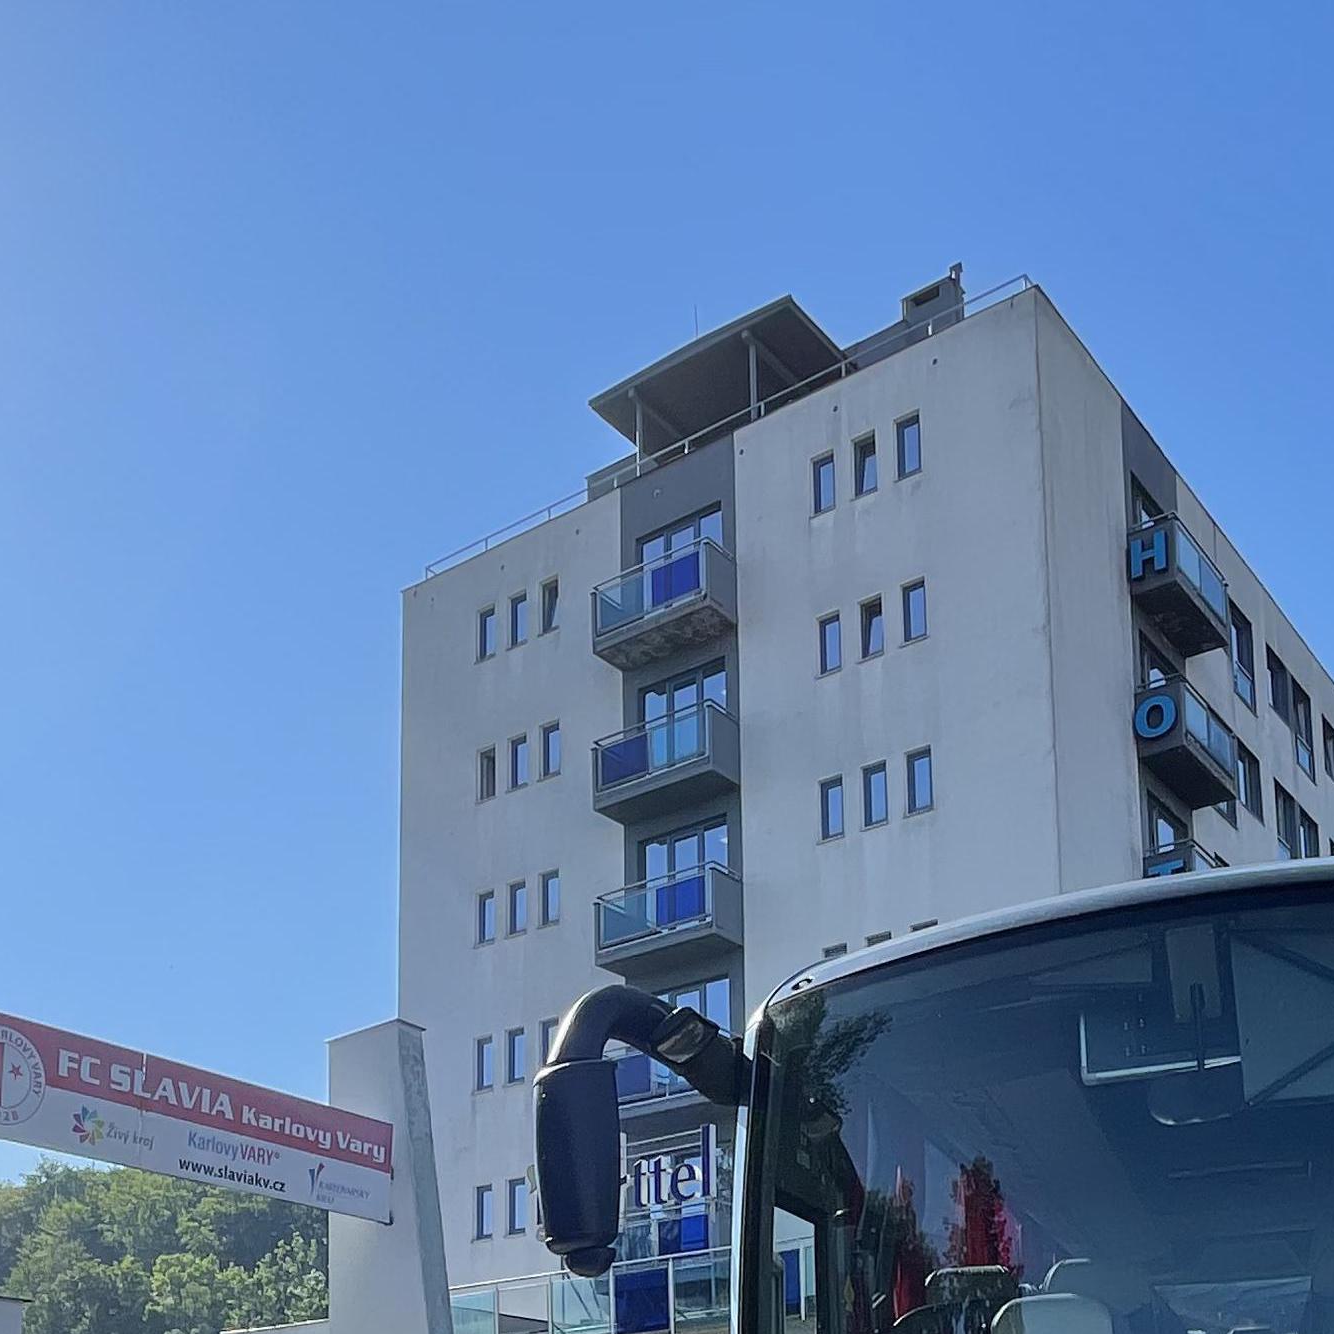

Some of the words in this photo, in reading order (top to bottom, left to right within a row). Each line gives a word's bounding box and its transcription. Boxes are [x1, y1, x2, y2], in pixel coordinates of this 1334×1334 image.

[58, 1049, 101, 1086] FC
[110, 1063, 234, 1120] SLAVIA
[242, 1105, 331, 1149] Karlovy
[336, 1131, 385, 1163] Vary
[178, 1158, 286, 1193] www.slaviakv.cz
[620, 1123, 716, 1209] ttel
